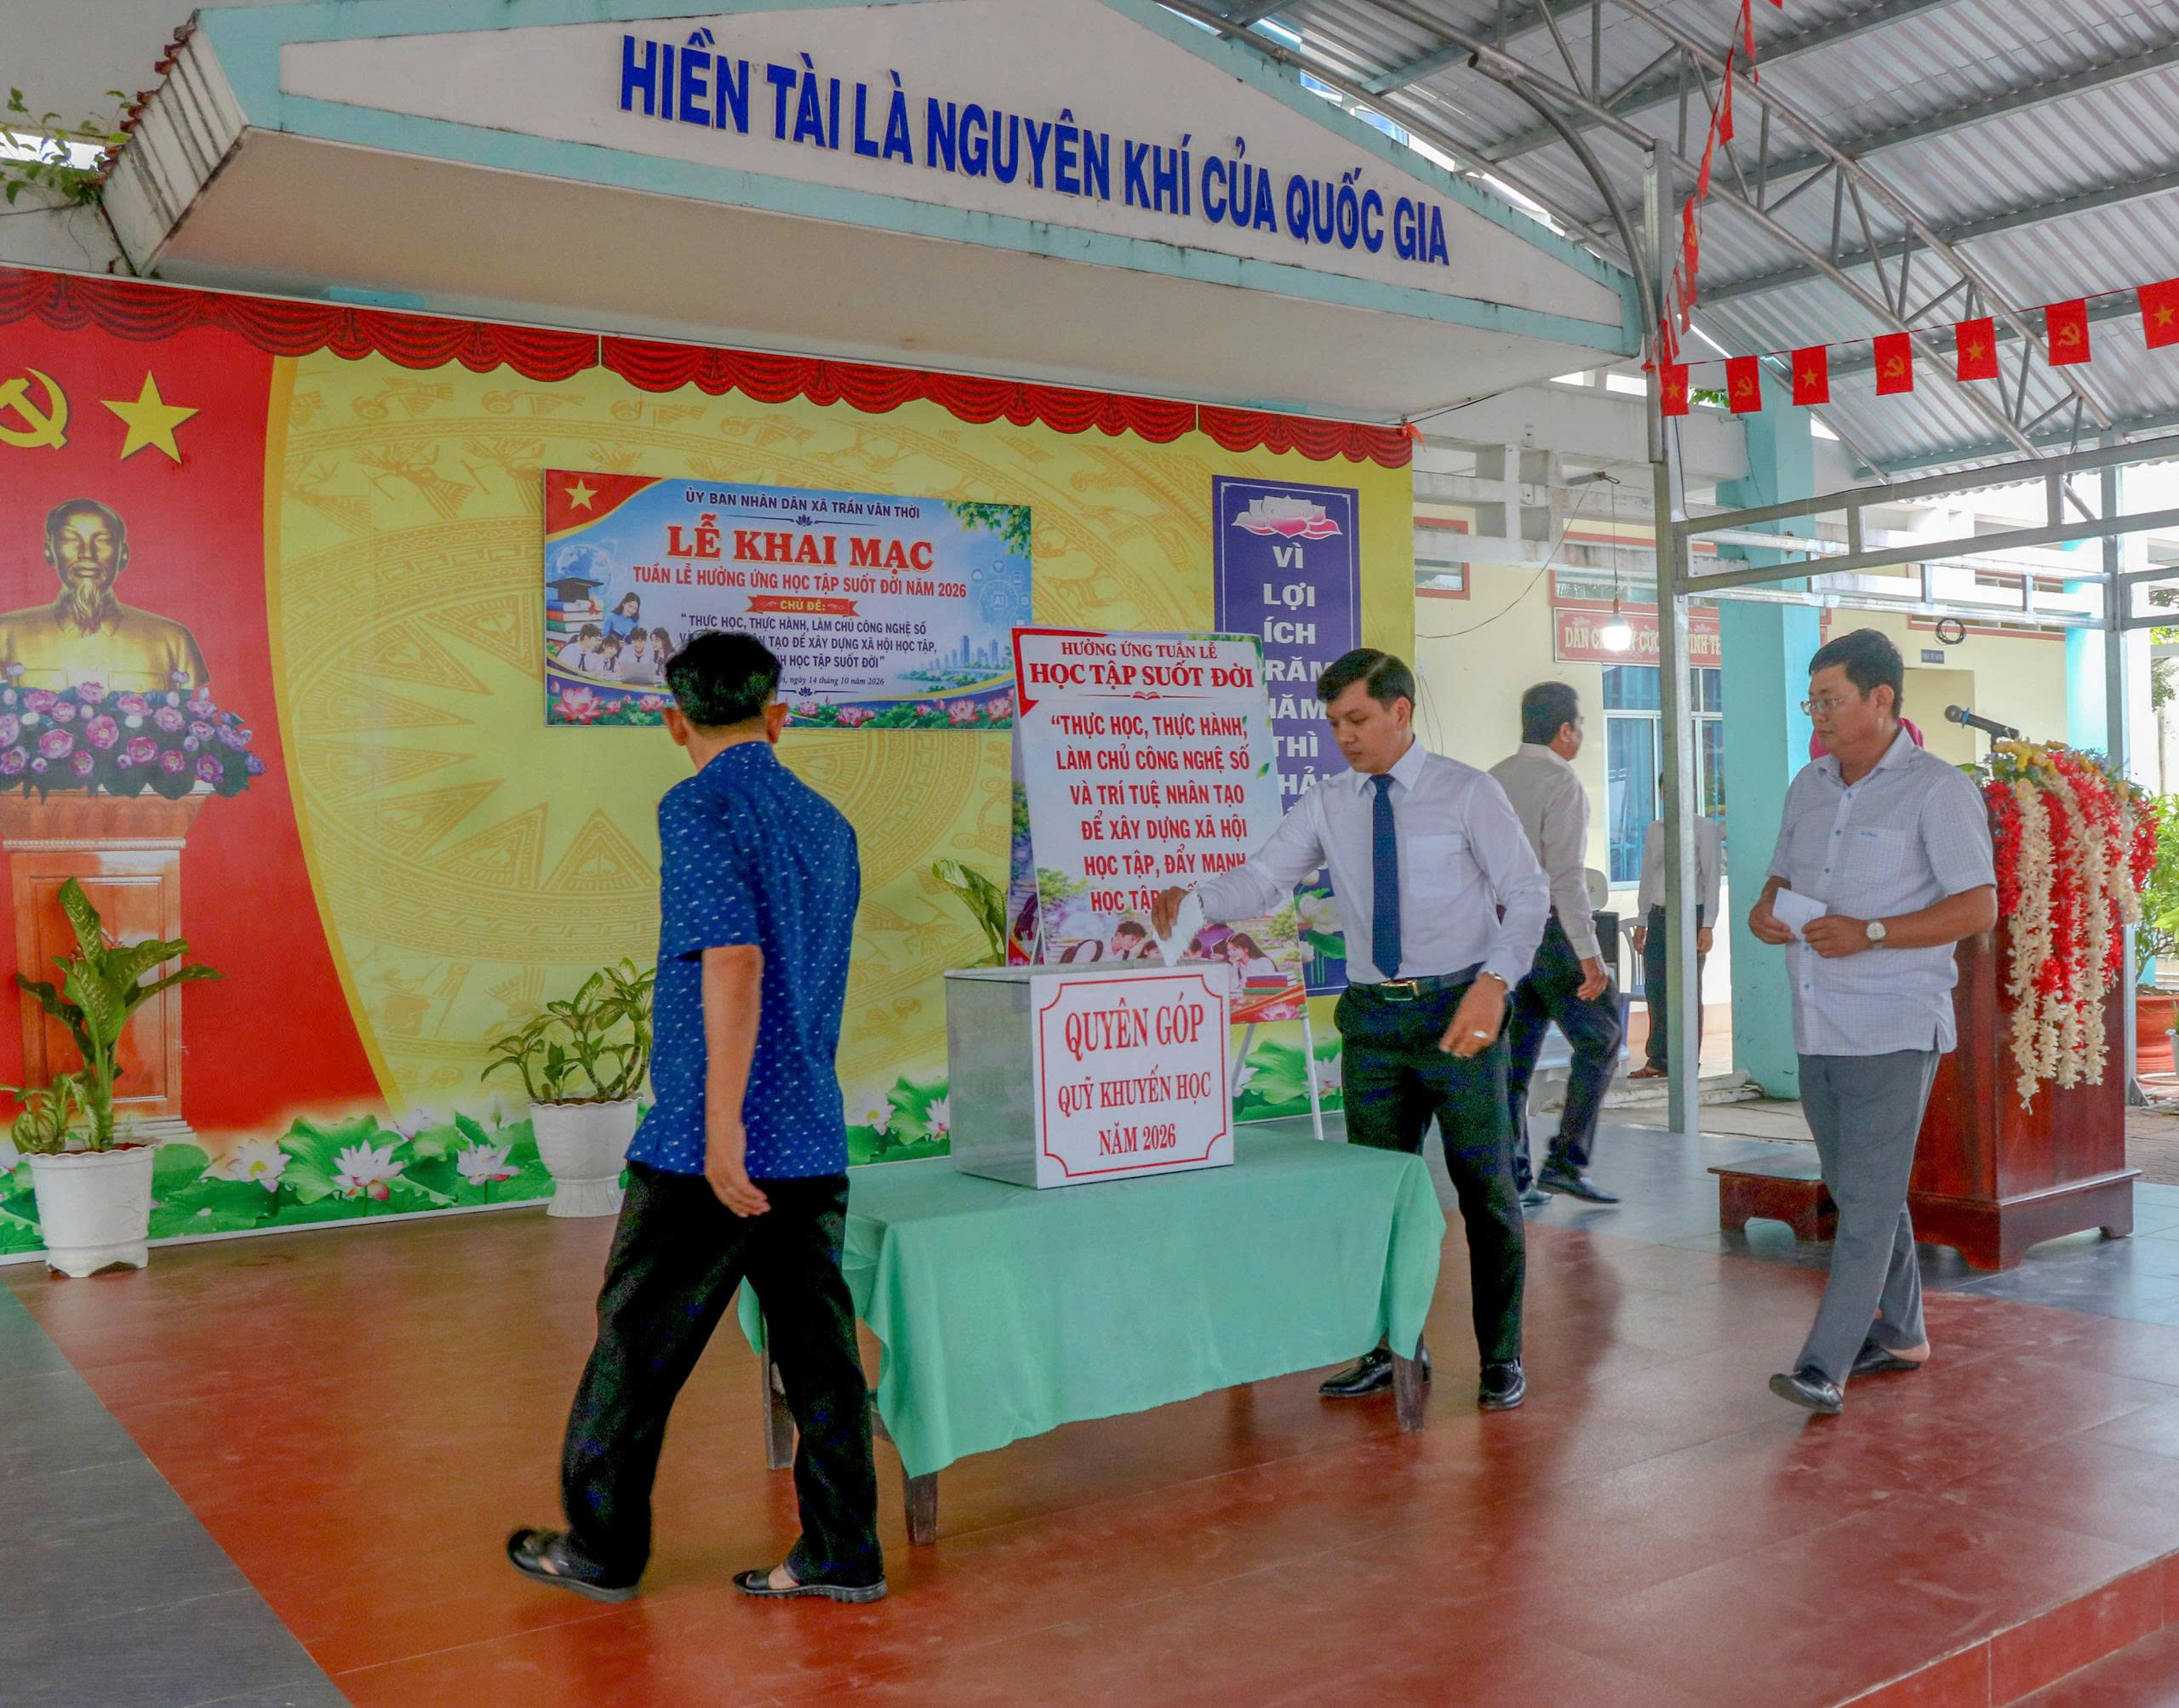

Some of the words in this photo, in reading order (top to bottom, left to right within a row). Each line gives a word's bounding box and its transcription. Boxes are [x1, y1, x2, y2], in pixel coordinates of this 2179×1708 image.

[620, 26, 750, 134] HIỀN
[766, 51, 841, 150] TÀI
[854, 69, 912, 164] LÀ
[928, 96, 1112, 202] NGUYÊN
[1124, 133, 1192, 217] KHÍ
[1200, 134, 1278, 233] CỦA
[1285, 166, 1385, 255] QUỐC
[1393, 193, 1450, 266] GIA
[685, 487, 704, 503] ỦY
[710, 493, 736, 506] BAN
[741, 494, 776, 508] NHÂN
[782, 496, 807, 510] DÂN
[812, 498, 827, 512] XÃ
[894, 504, 919, 518] THỜI
[667, 513, 721, 558] LỄ
[734, 530, 837, 565] KHAI
[849, 537, 934, 574] MẠC
[1273, 543, 1304, 568] VÌ
[633, 559, 670, 584] TUẦN
[676, 563, 692, 585] LỄ
[697, 566, 745, 586] HƯỞNG
[750, 568, 778, 589] ỨNG
[783, 574, 809, 593] HỌC
[814, 573, 839, 595] TẬP
[844, 573, 876, 593] SUỐT
[880, 576, 901, 595] ĐỜI
[906, 578, 934, 597] NĂM
[938, 582, 966, 598] 2026
[1263, 583, 1315, 609] LỢI
[722, 617, 746, 630] HỌC,
[749, 617, 775, 631] THỰC
[812, 618, 832, 631] LÀM
[834, 618, 854, 631] CHỦ
[857, 620, 882, 633] CÔNG
[885, 621, 911, 637] NGHỆ
[914, 620, 926, 634] SỐ
[1263, 618, 1316, 644] ÍCH
[769, 636, 789, 649] TẠO
[792, 632, 805, 648] ĐỂ
[809, 635, 828, 648] XÂY
[832, 637, 858, 652] DỰNG
[861, 638, 874, 650] XÃ
[877, 639, 893, 653] HỘI
[896, 642, 915, 654] HỌC
[918, 639, 936, 654] TẬP,
[1061, 640, 1117, 656] HƯỞNG
[1121, 641, 1152, 657] ỨNG
[1156, 642, 1196, 659] TUẦN
[1199, 642, 1217, 660] LỄ
[790, 655, 809, 669] HỌC
[813, 654, 831, 669] TẬP
[834, 653, 859, 667] SUỐT
[1029, 663, 1086, 689] HỌC
[1090, 660, 1136, 690] TẬP
[1142, 660, 1204, 688] SUỐT
[1210, 663, 1255, 688] ĐỜI
[1051, 712, 1105, 740] “THỰC
[1110, 715, 1148, 740] HỌC,
[1152, 713, 1195, 740] THỰC
[1200, 711, 1248, 740] HÀNH,
[1055, 745, 1092, 770] LÀM
[1097, 743, 1130, 770] CHỦ
[1135, 745, 1178, 770] CÔNG
[1182, 745, 1224, 774] NGHỆ
[1229, 744, 1250, 769] SỐ
[1070, 780, 1093, 805] VÀ
[1096, 780, 1124, 804] TRÍ
[1129, 780, 1161, 808] TUỆ
[1166, 780, 1210, 804] NHÂN
[1213, 785, 1244, 808] TẠO
[1081, 810, 1104, 841] ĐỂ
[1109, 815, 1140, 840] XÂY
[1147, 816, 1191, 843] DỰNG
[1195, 814, 1215, 838] XÃ
[1221, 814, 1247, 842] HỘI
[1084, 855, 1118, 880] HỌC
[1122, 849, 1160, 879] TẬP,
[1164, 843, 1195, 874] ĐẨY
[1090, 891, 1124, 916] HỌC
[1065, 997, 1148, 1062] QUYÊN
[1156, 991, 1204, 1046] GÓP
[1058, 1076, 1094, 1117] QUỸ
[1100, 1064, 1171, 1108] KHUYẾN
[1175, 1071, 1211, 1105] HỌC
[1099, 1121, 1138, 1156] NĂM
[1142, 1123, 1176, 1150] 2026
